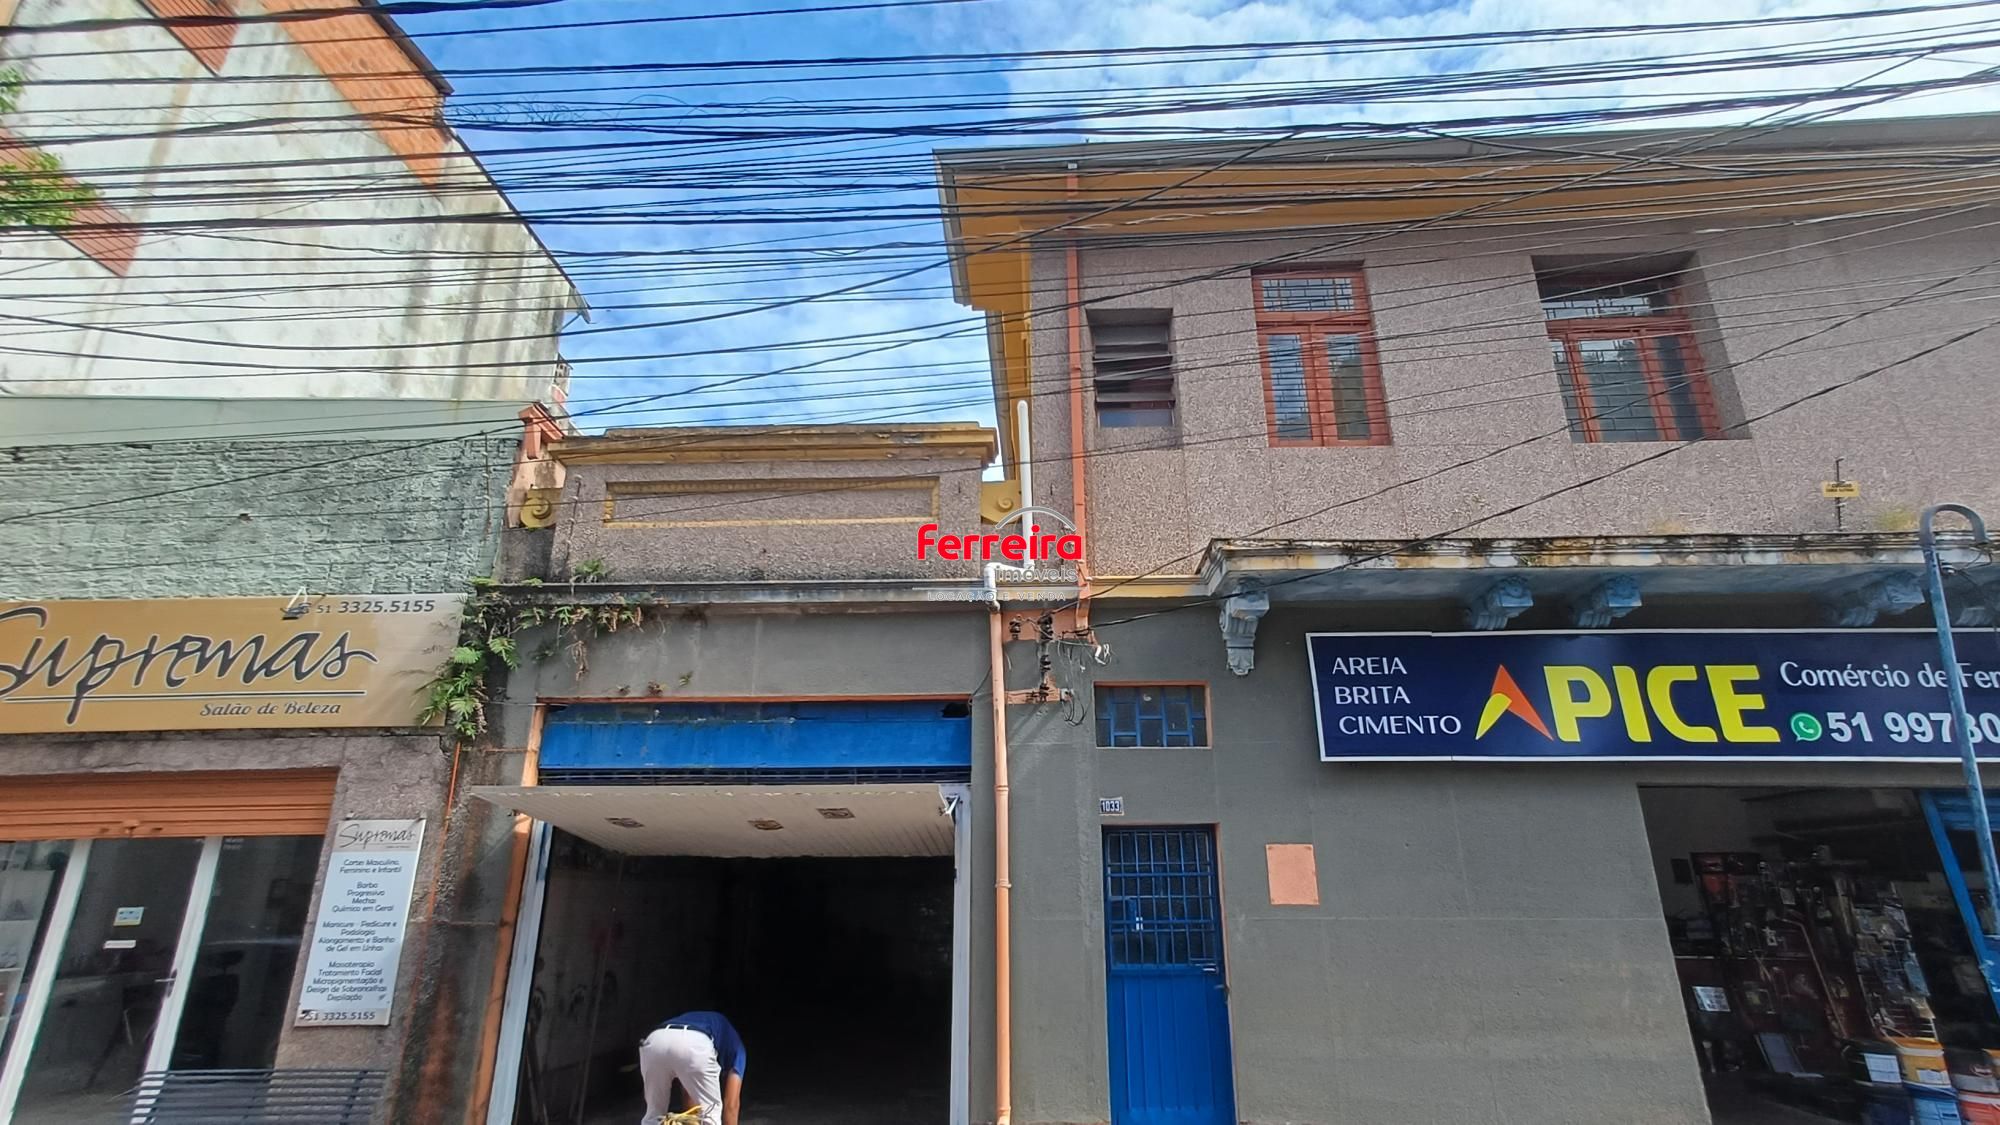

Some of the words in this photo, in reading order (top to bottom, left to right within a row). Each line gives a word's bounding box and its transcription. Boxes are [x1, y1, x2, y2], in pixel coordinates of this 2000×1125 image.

[316, 605, 332, 613] 51
[338, 600, 435, 613] 3325.5155
[1332, 657, 1407, 675] AREIA
[1780, 661, 1910, 688] Comércio
[1917, 662, 1948, 688] de
[1335, 686, 1411, 704] BRITA
[1475, 664, 1781, 742] APICE
[200, 703, 252, 716] Salão
[257, 702, 279, 715] de
[284, 700, 342, 714] Beleza
[1339, 715, 1462, 735] CIMENTO
[1827, 712, 1873, 743] 51
[1102, 800, 1120, 812] 1033
